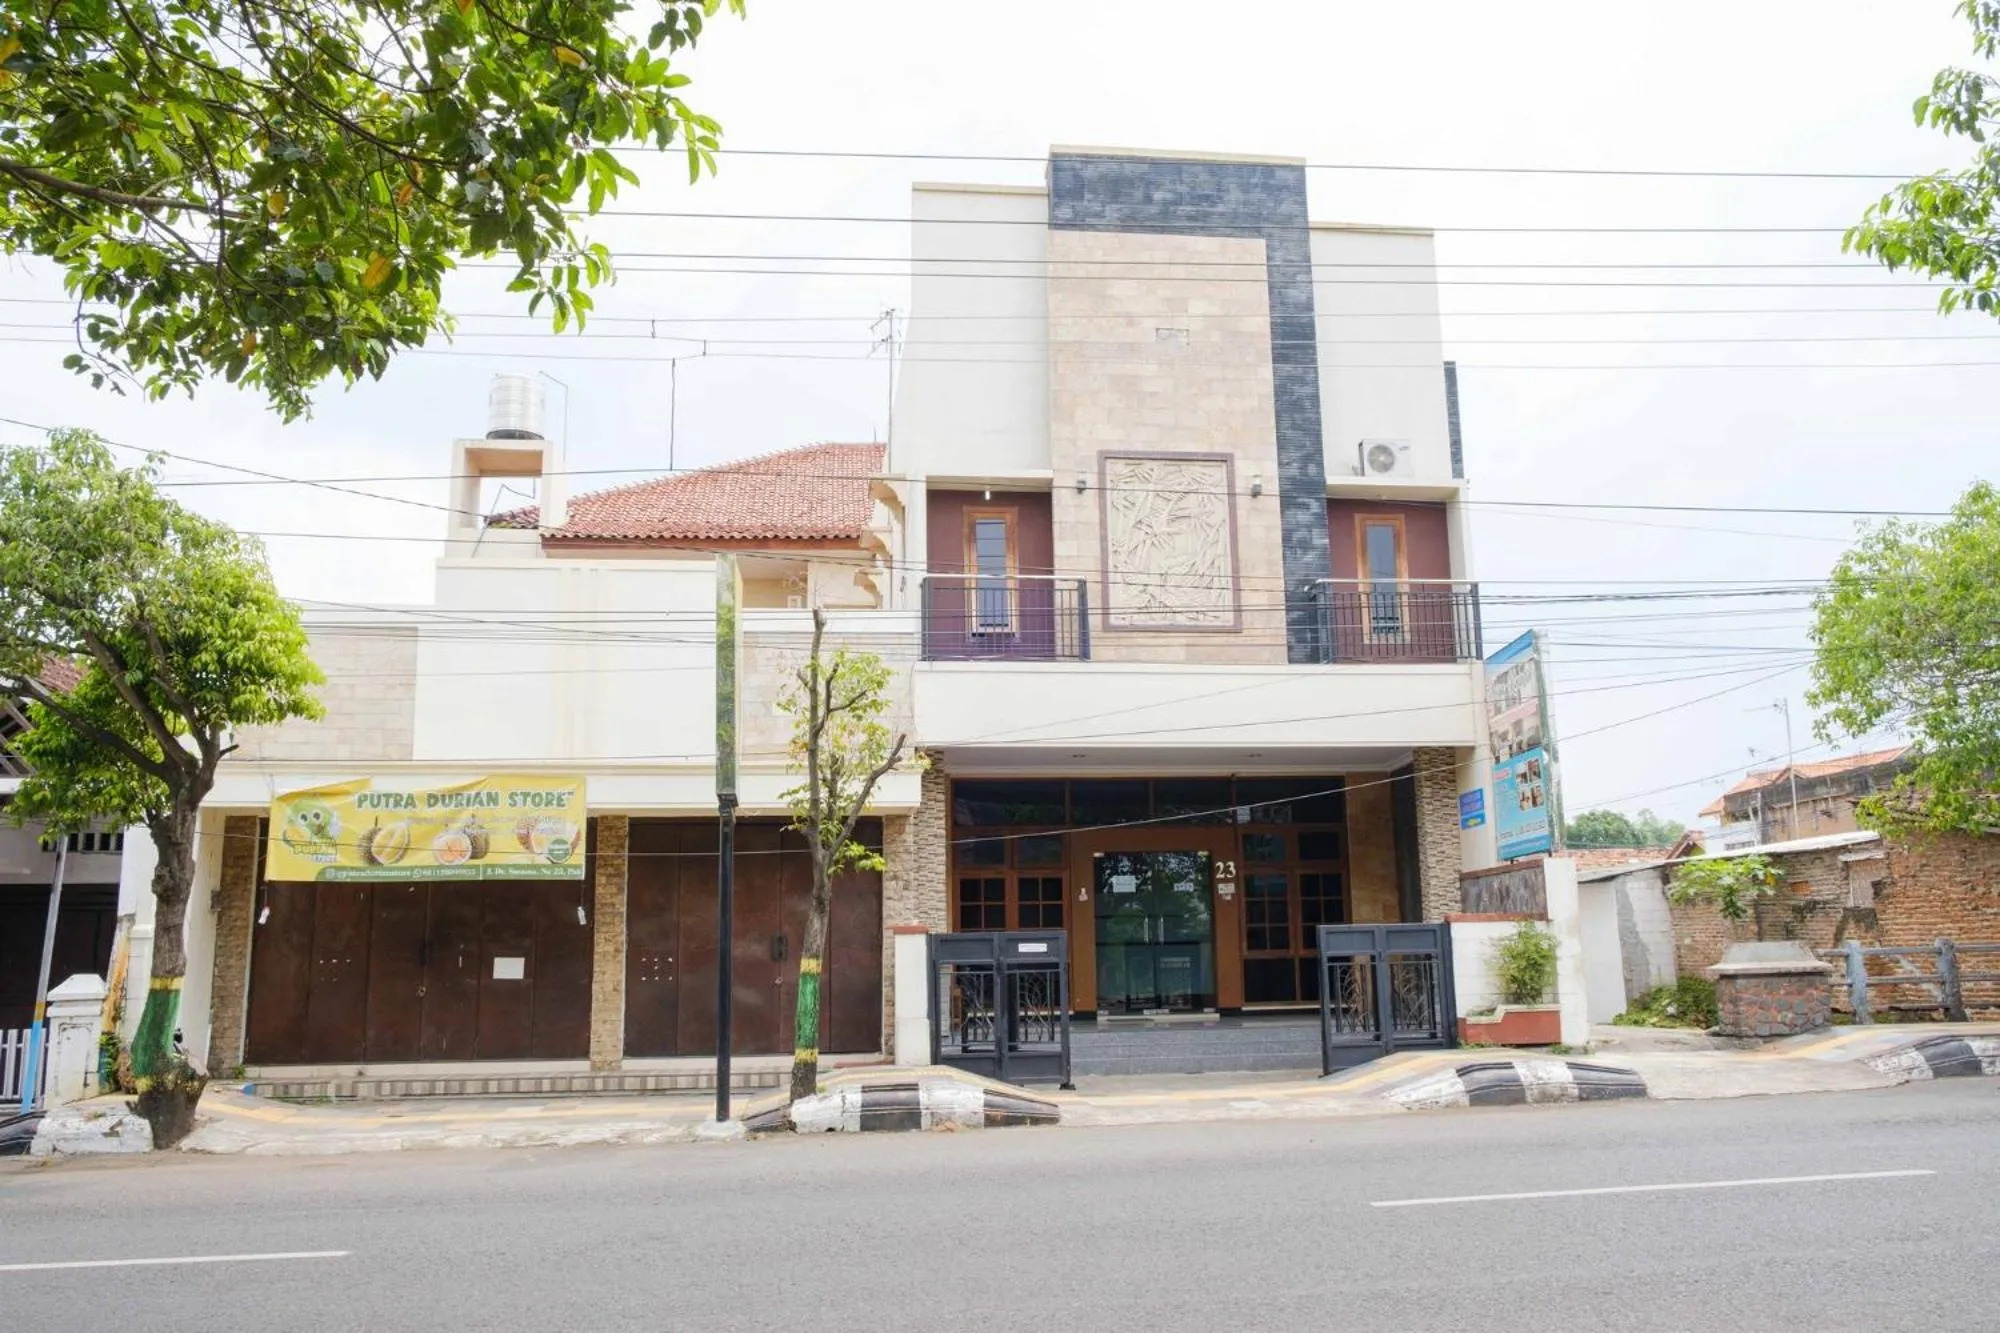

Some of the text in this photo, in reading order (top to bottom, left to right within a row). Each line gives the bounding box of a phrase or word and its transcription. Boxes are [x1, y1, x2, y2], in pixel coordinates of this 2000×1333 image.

[356, 792, 417, 809] PUTRA
[426, 791, 500, 809] DURIAN
[1215, 861, 1236, 878] 23
